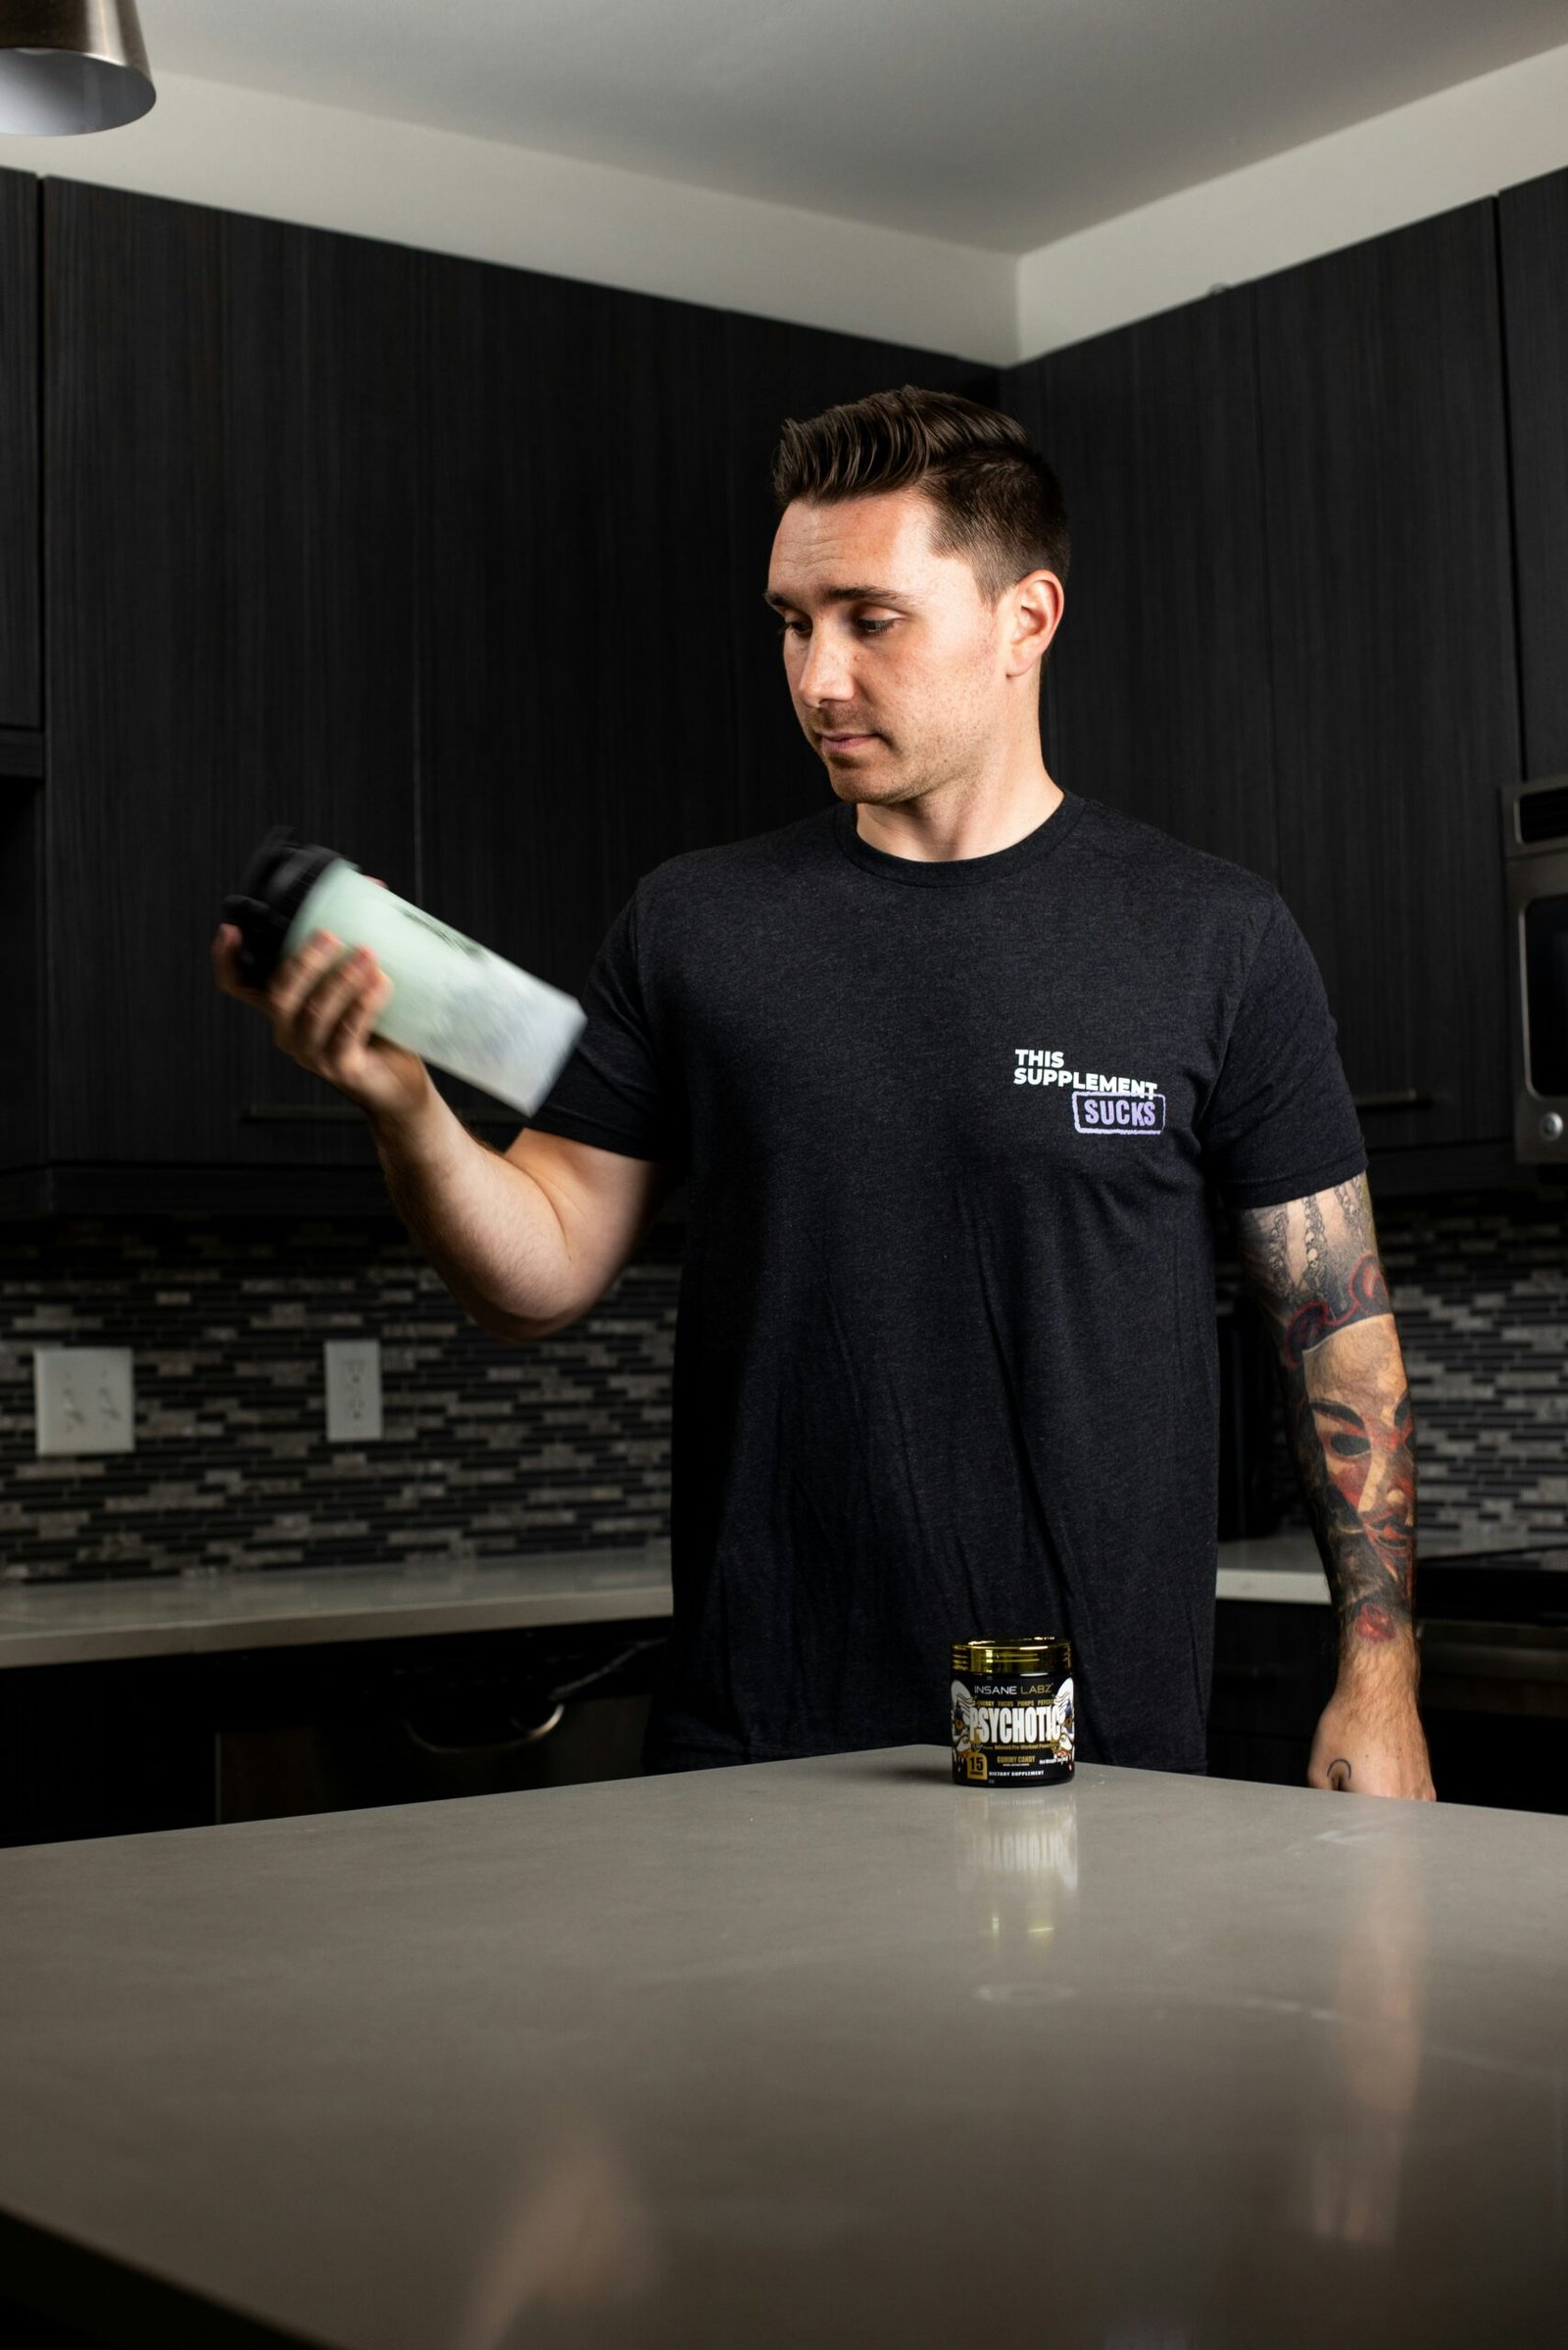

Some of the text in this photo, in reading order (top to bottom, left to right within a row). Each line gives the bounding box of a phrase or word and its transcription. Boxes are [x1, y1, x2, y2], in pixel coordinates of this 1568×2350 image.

[1014, 1049, 1064, 1068] THIS
[1013, 1067, 1157, 1100] SUPPLEMENT
[1084, 1099, 1155, 1127] SUCKS
[974, 1685, 1052, 1695] INSANE LABZ
[969, 1706, 1061, 1743] PSYCHOTIC
[969, 1756, 984, 1771] 15
